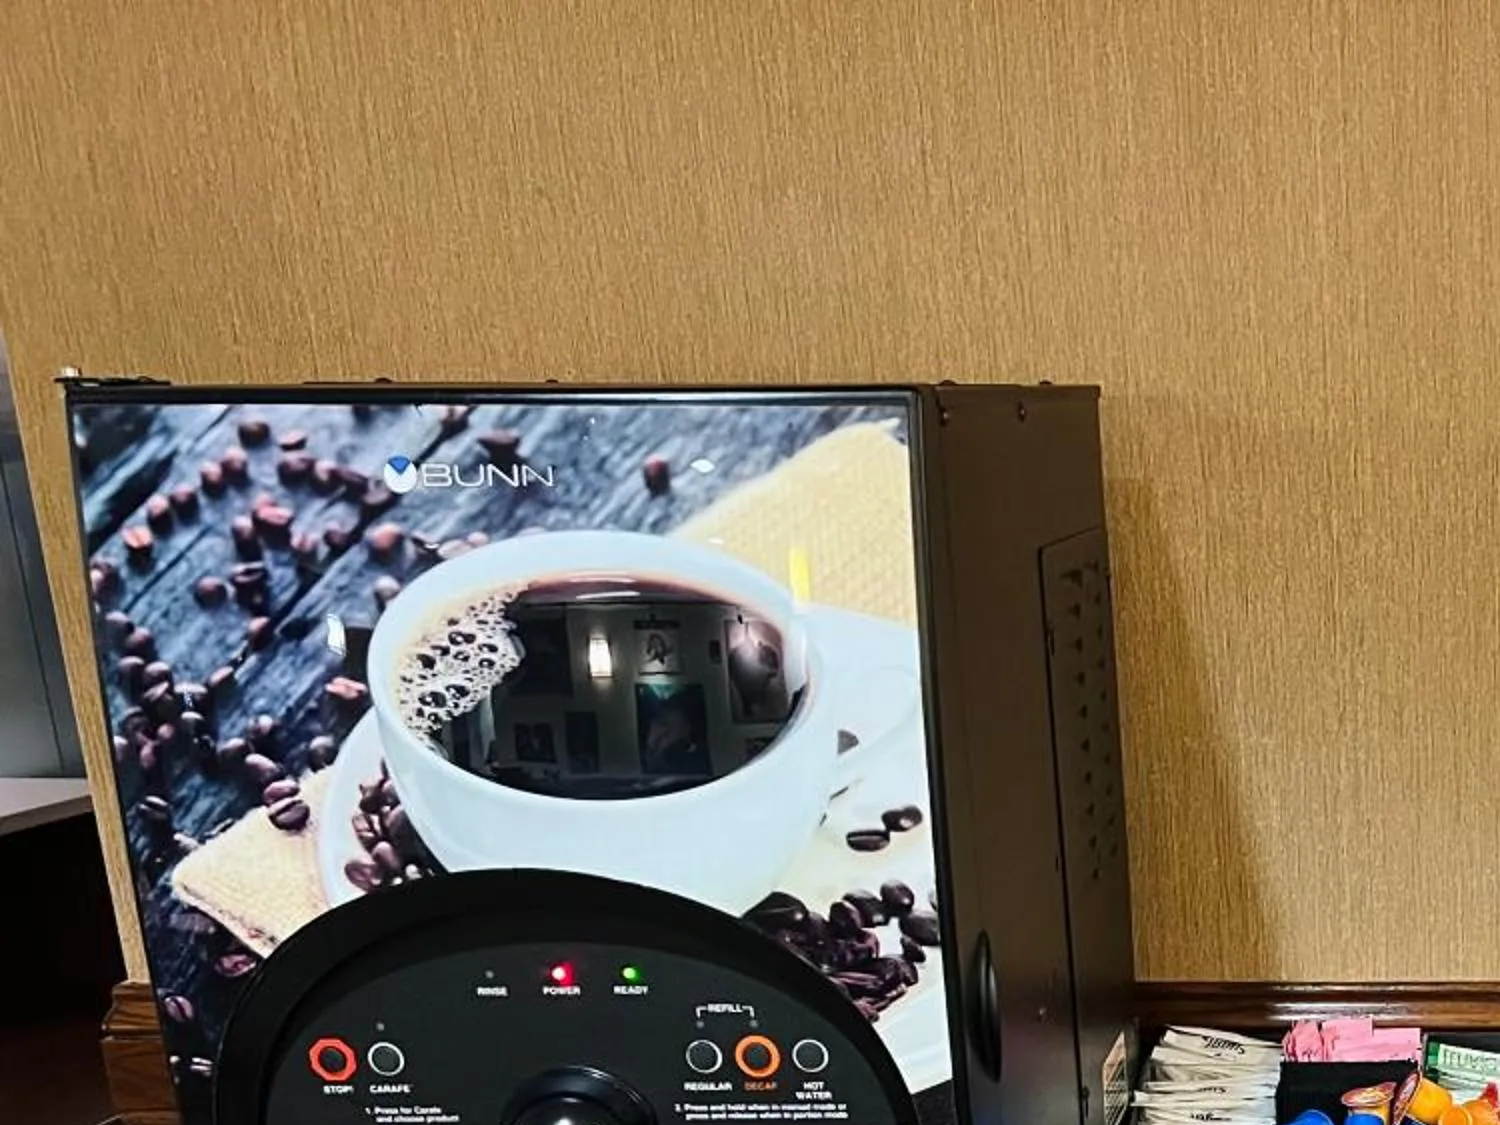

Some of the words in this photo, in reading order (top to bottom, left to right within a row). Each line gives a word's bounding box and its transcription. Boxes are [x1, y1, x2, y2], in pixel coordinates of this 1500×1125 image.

[421, 463, 554, 487] BUNN
[477, 987, 507, 996] RINSE
[543, 986, 580, 995] POWER
[613, 986, 648, 995] READY
[708, 1003, 743, 1013] REFILL
[323, 1085, 354, 1094] STOP
[369, 1084, 411, 1093] CARAFE
[684, 1081, 733, 1091] REGULAR
[744, 1081, 777, 1091] DECAF
[803, 1081, 824, 1090] HOT
[795, 1091, 833, 1100] WATER
